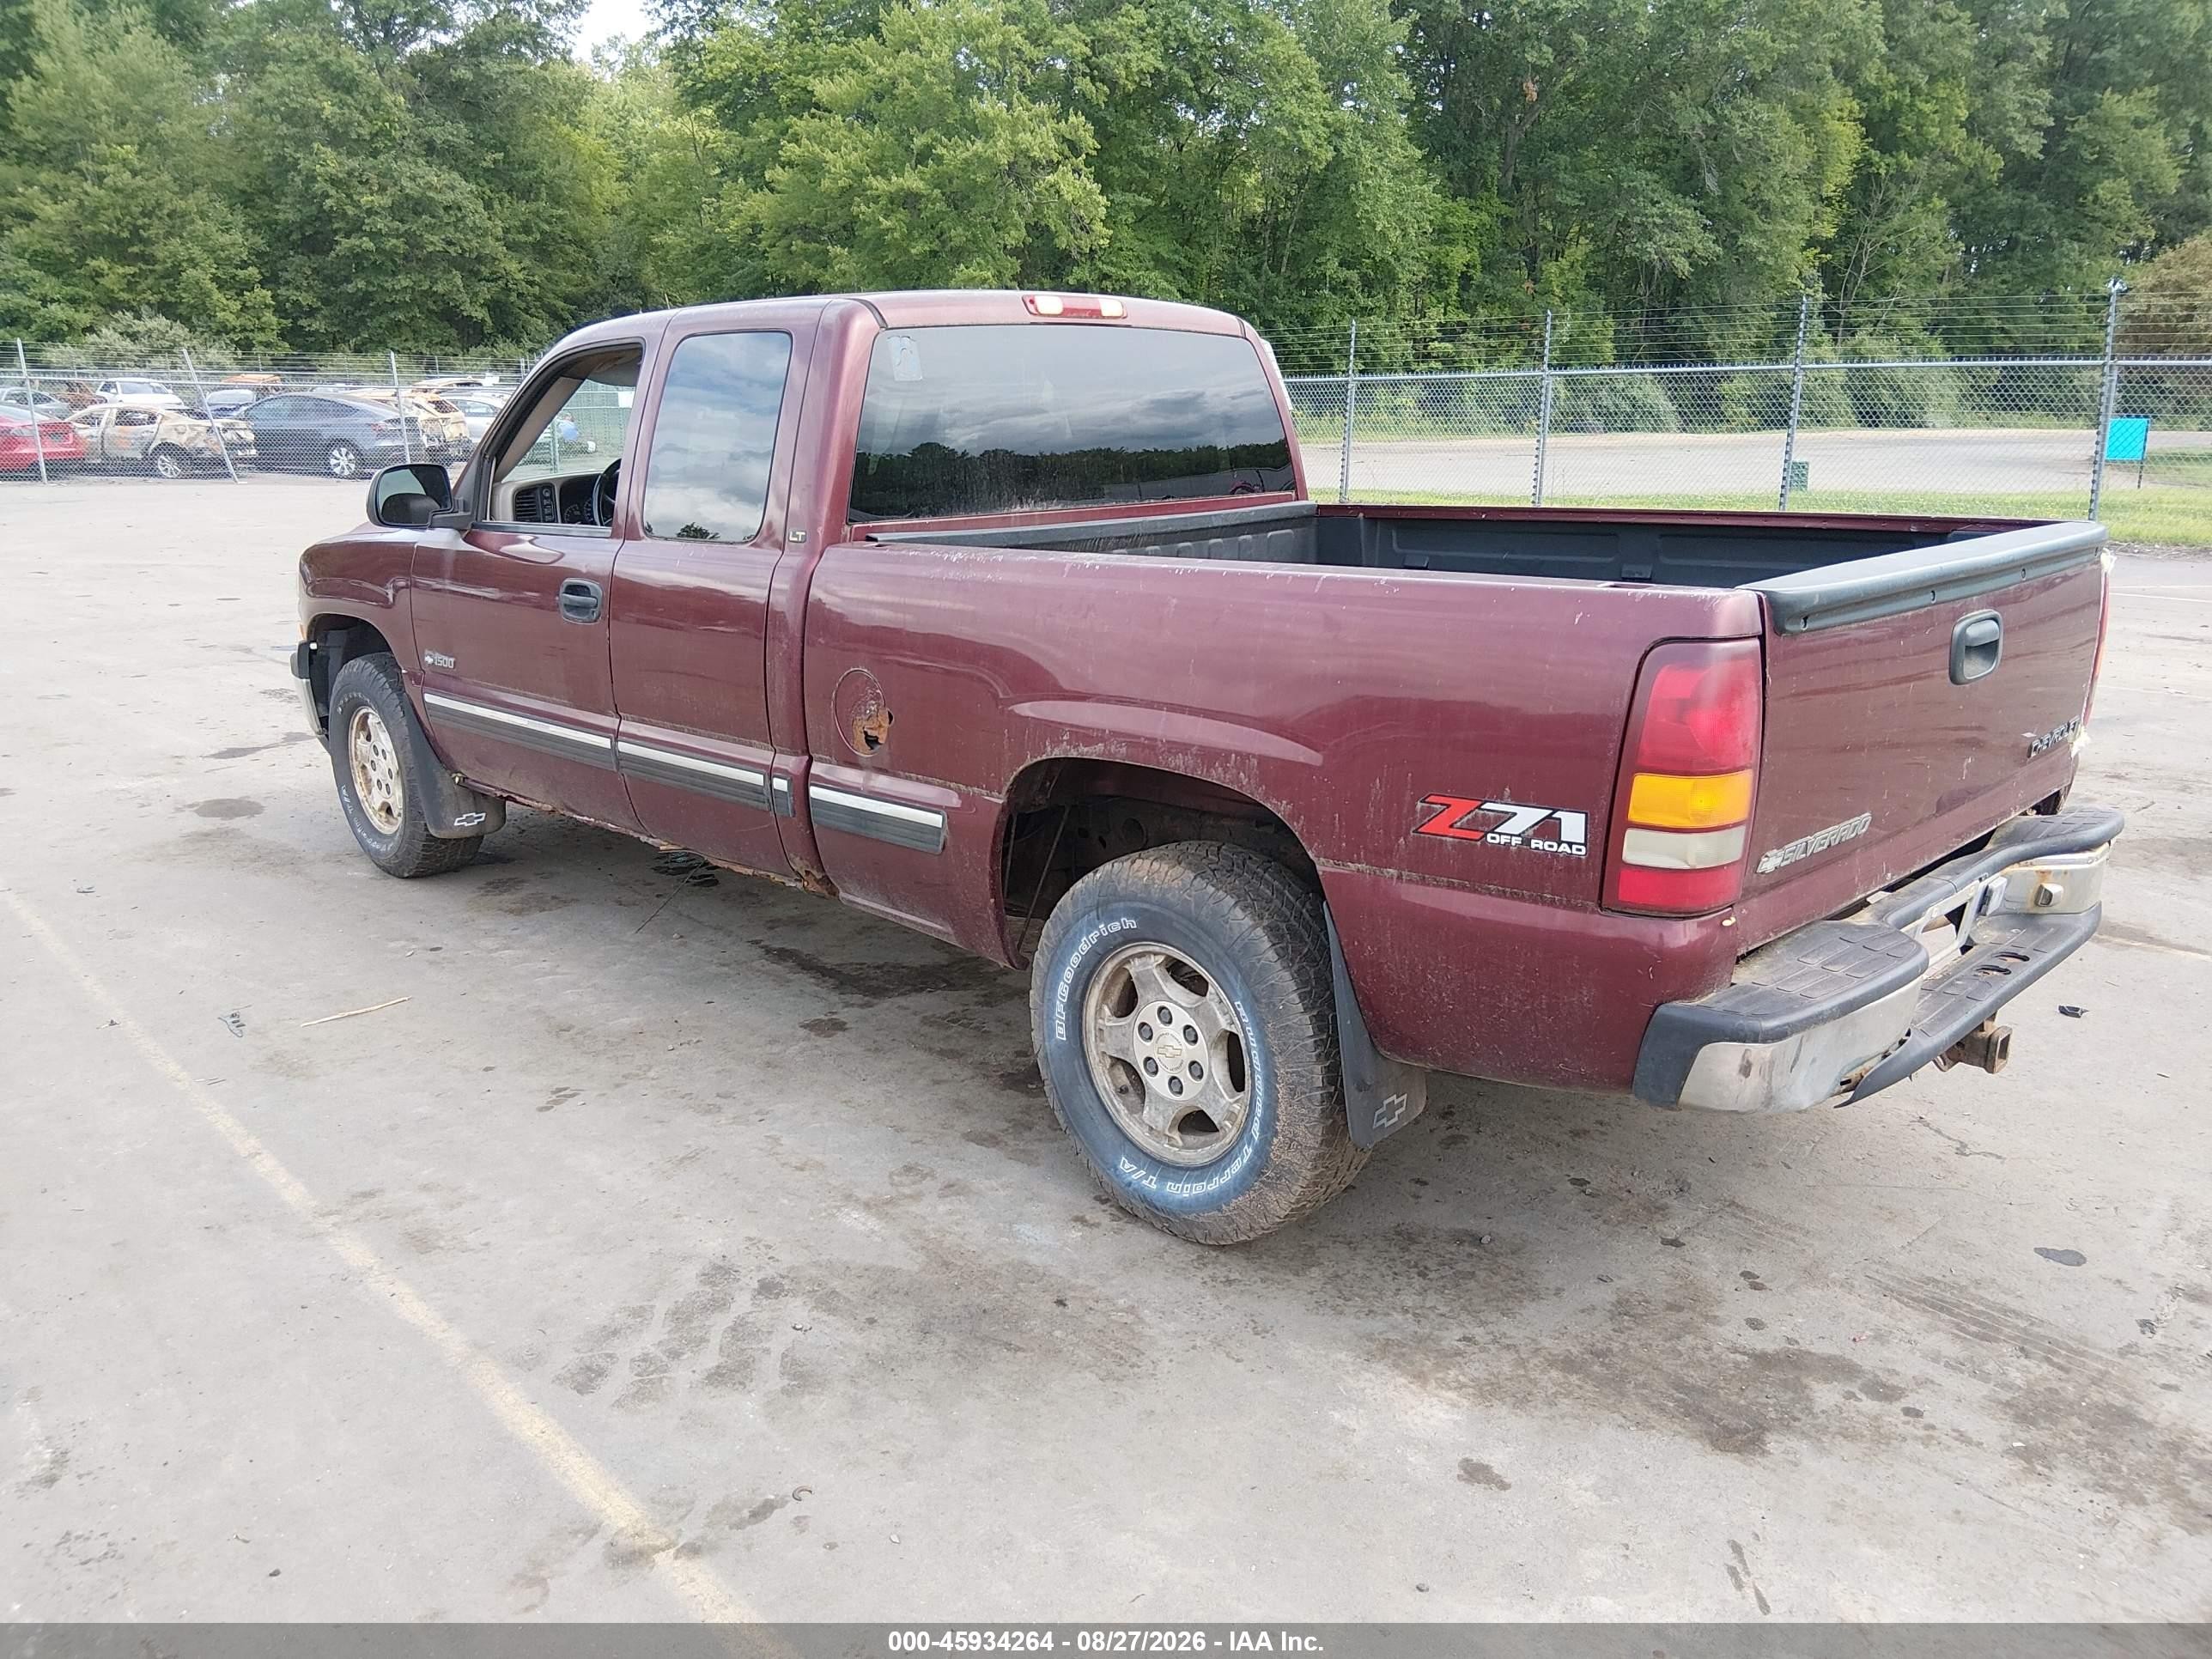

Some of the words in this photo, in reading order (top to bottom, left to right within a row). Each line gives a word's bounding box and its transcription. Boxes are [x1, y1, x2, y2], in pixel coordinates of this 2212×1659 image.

[789, 531, 806, 542] LT
[434, 654, 455, 669] 1500
[1412, 793, 1589, 844] Z71
[1486, 833, 1522, 847] OFF
[1530, 838, 1587, 856] ROAD
[1780, 814, 1873, 867] SILVERADO
[1055, 917, 1138, 1041] BFGoodrich
[1120, 1157, 1158, 1189] T/A
[1166, 1144, 1253, 1197] Terrain
